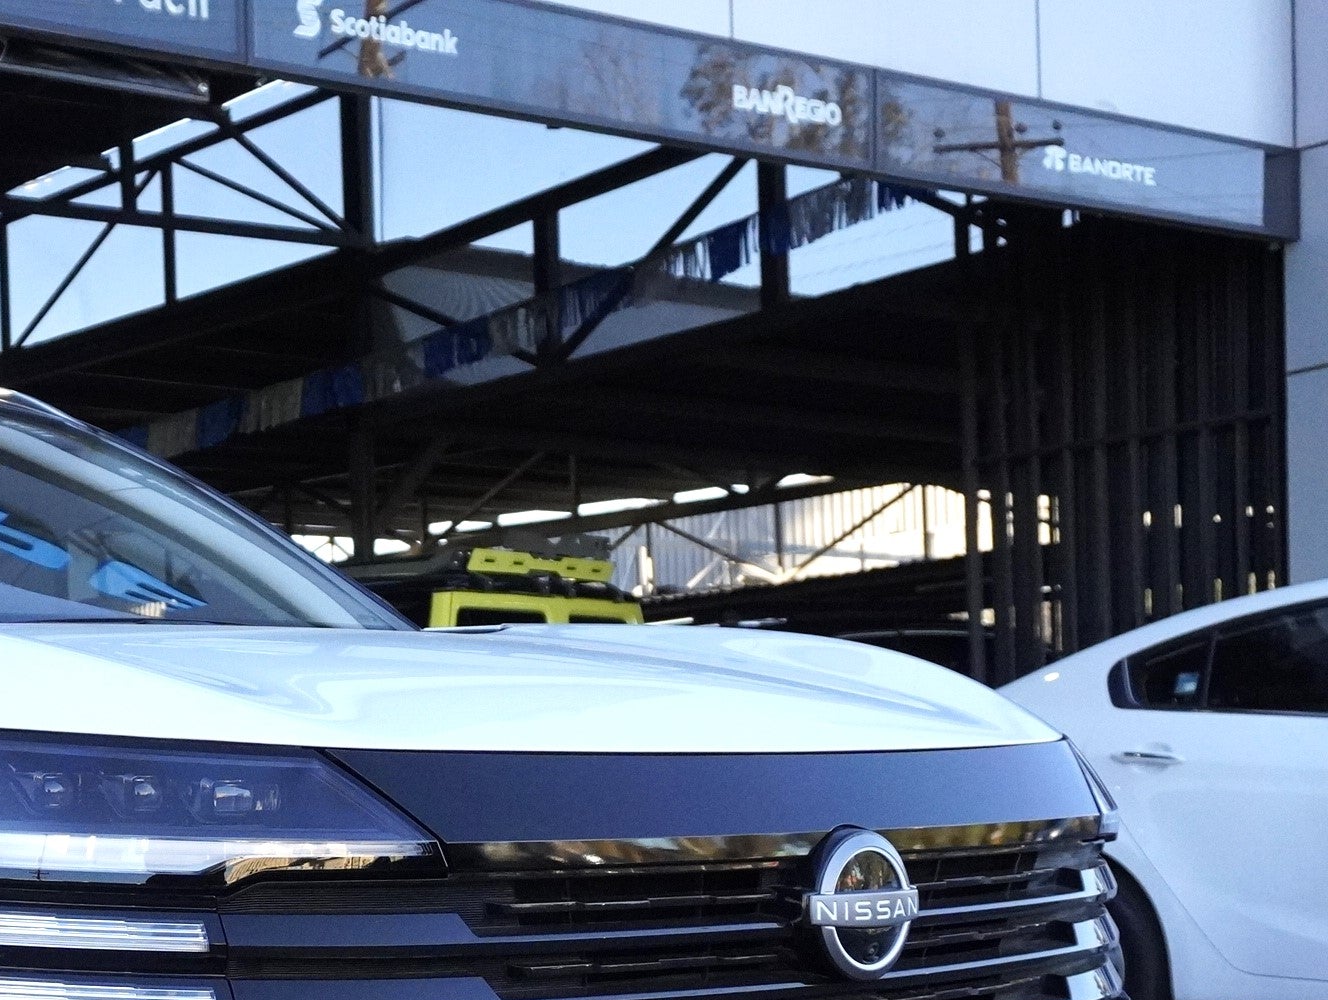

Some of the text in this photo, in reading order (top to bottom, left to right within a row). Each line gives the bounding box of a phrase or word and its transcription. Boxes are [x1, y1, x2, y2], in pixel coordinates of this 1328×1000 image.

[330, 9, 458, 54] Scotiabank
[1068, 153, 1157, 186] BANORTE
[816, 895, 918, 921] NISSAN
